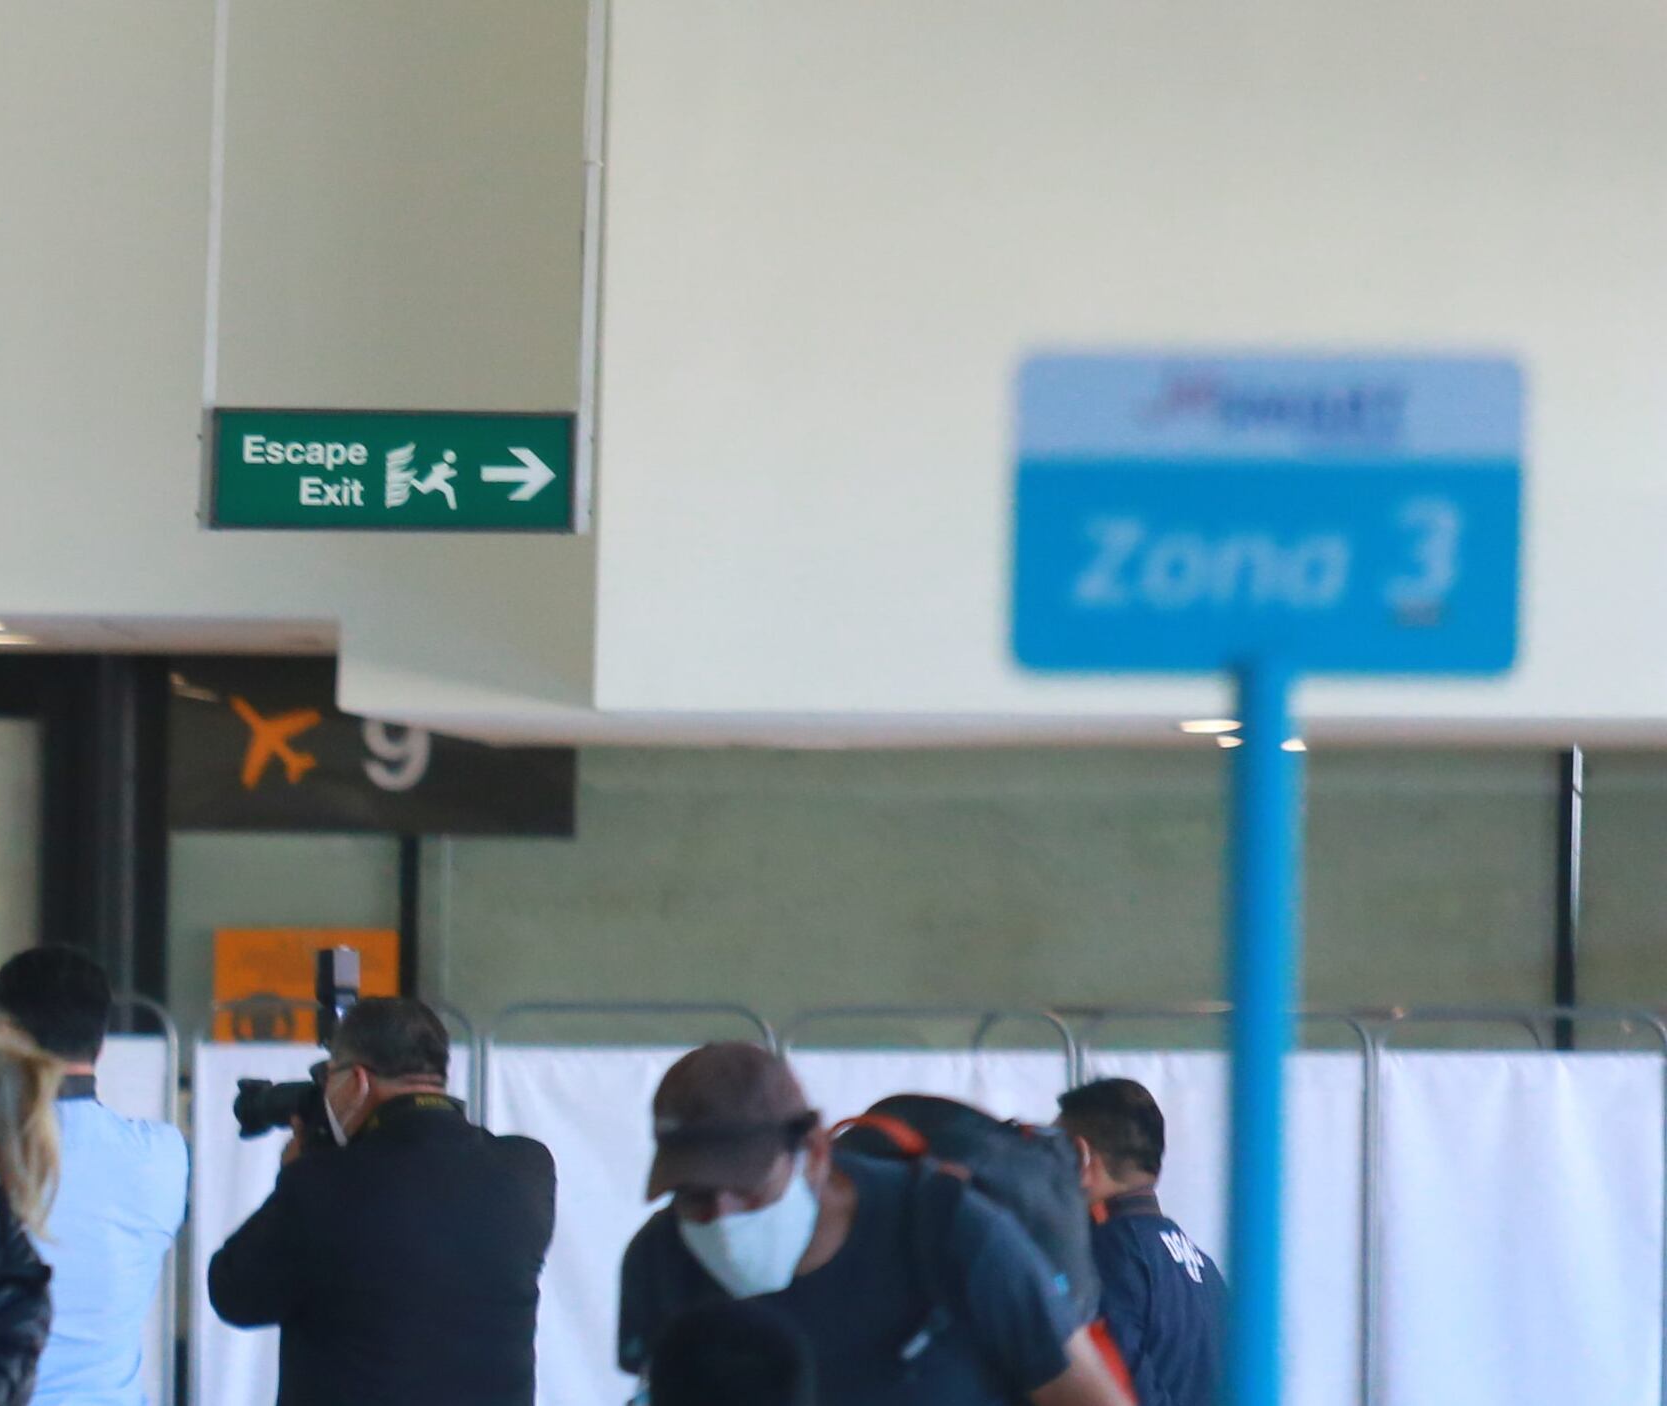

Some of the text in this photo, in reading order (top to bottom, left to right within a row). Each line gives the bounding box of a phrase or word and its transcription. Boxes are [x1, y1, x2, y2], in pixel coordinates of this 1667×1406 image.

[242, 434, 368, 471] Escape
[299, 476, 364, 506] Exit
[1073, 497, 1460, 610] Zona 3
[362, 719, 429, 791] 9
